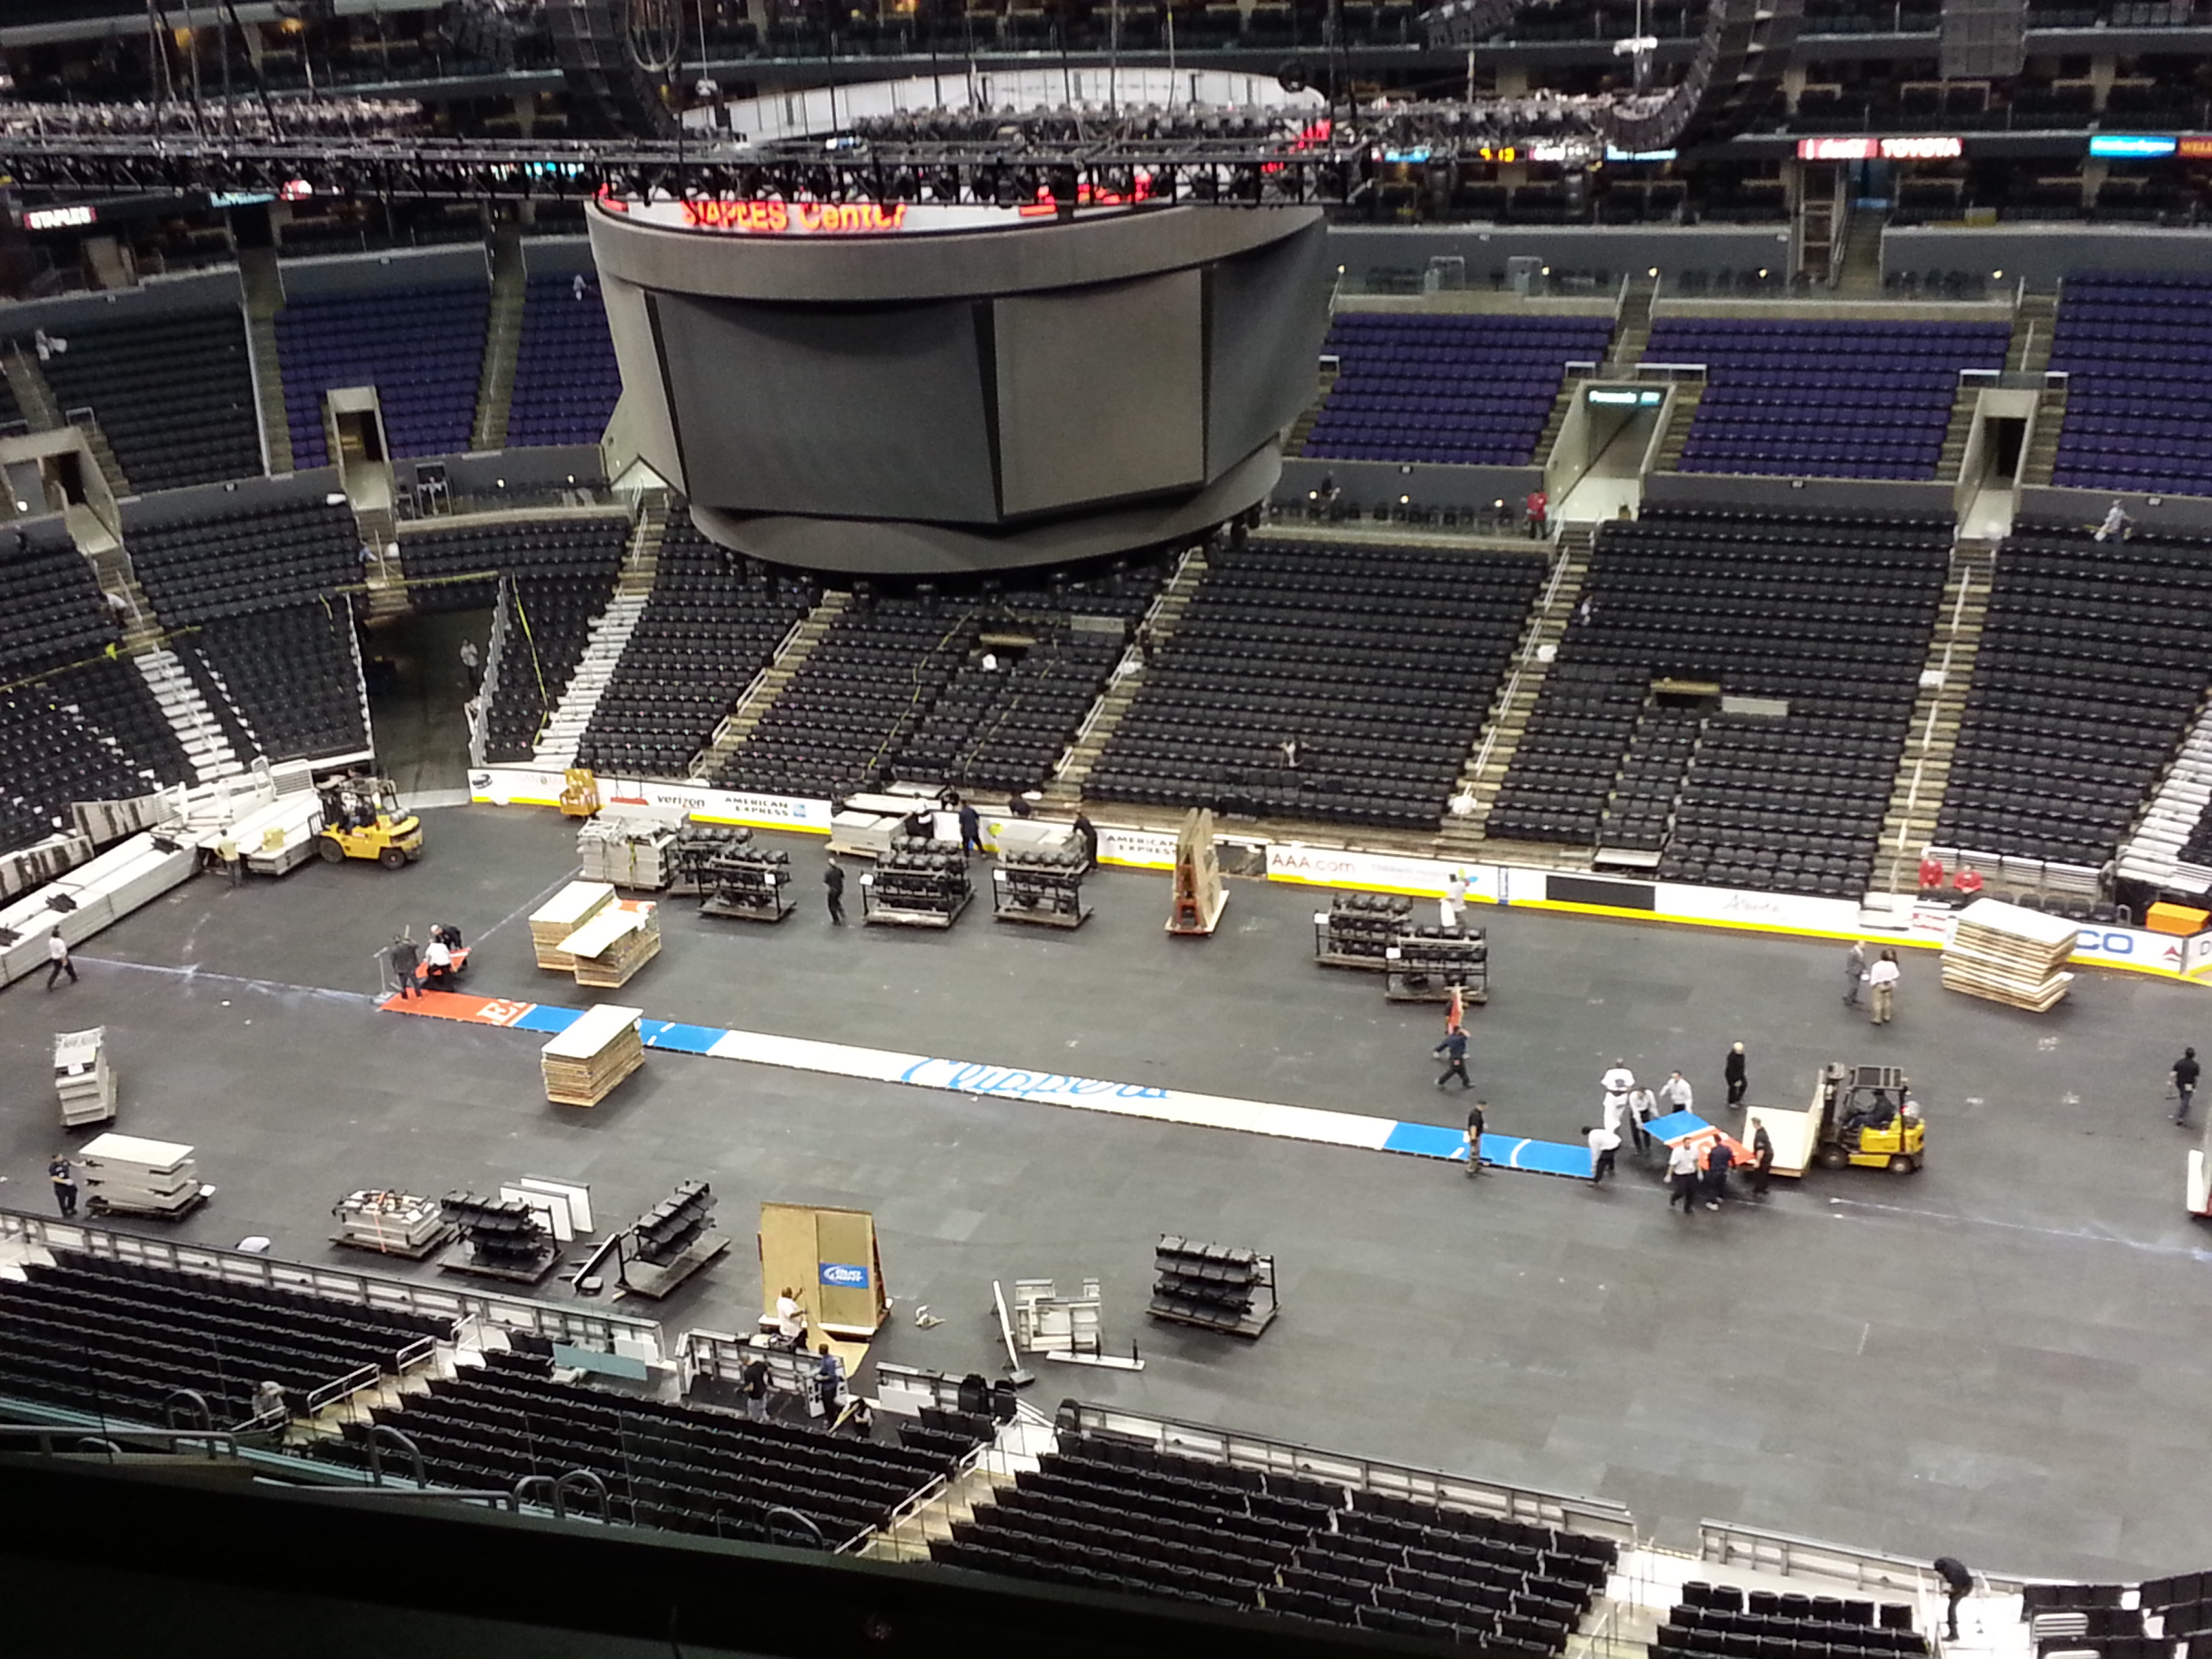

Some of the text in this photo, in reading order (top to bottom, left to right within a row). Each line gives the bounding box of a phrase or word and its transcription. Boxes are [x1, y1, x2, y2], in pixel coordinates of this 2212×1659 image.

[1881, 138, 1961, 157] TOYOTA
[657, 794, 705, 808] verizon
[725, 796, 788, 808] AMERICAN
